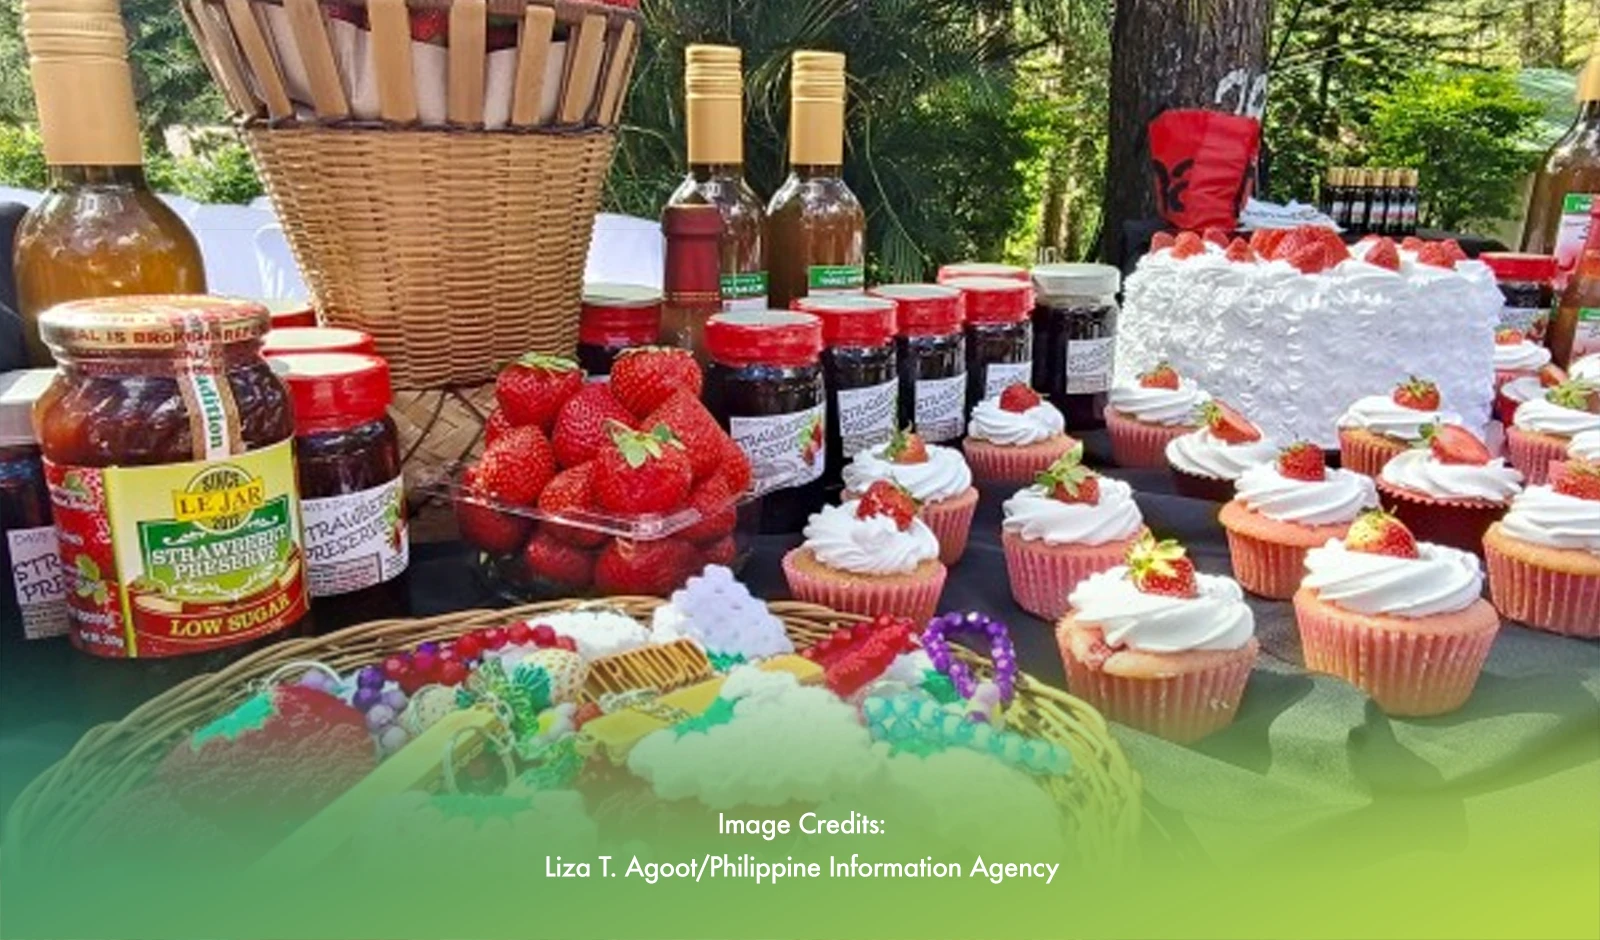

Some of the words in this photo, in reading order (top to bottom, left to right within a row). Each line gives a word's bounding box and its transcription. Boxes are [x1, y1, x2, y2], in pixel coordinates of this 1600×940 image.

[107, 331, 126, 344] IS
[181, 496, 213, 515] LE
[219, 486, 261, 514] JAR
[152, 523, 288, 565] STRAWBERRY
[174, 548, 278, 580] PRESERVE
[170, 617, 223, 637] LOW
[228, 593, 290, 632] SUGAR
